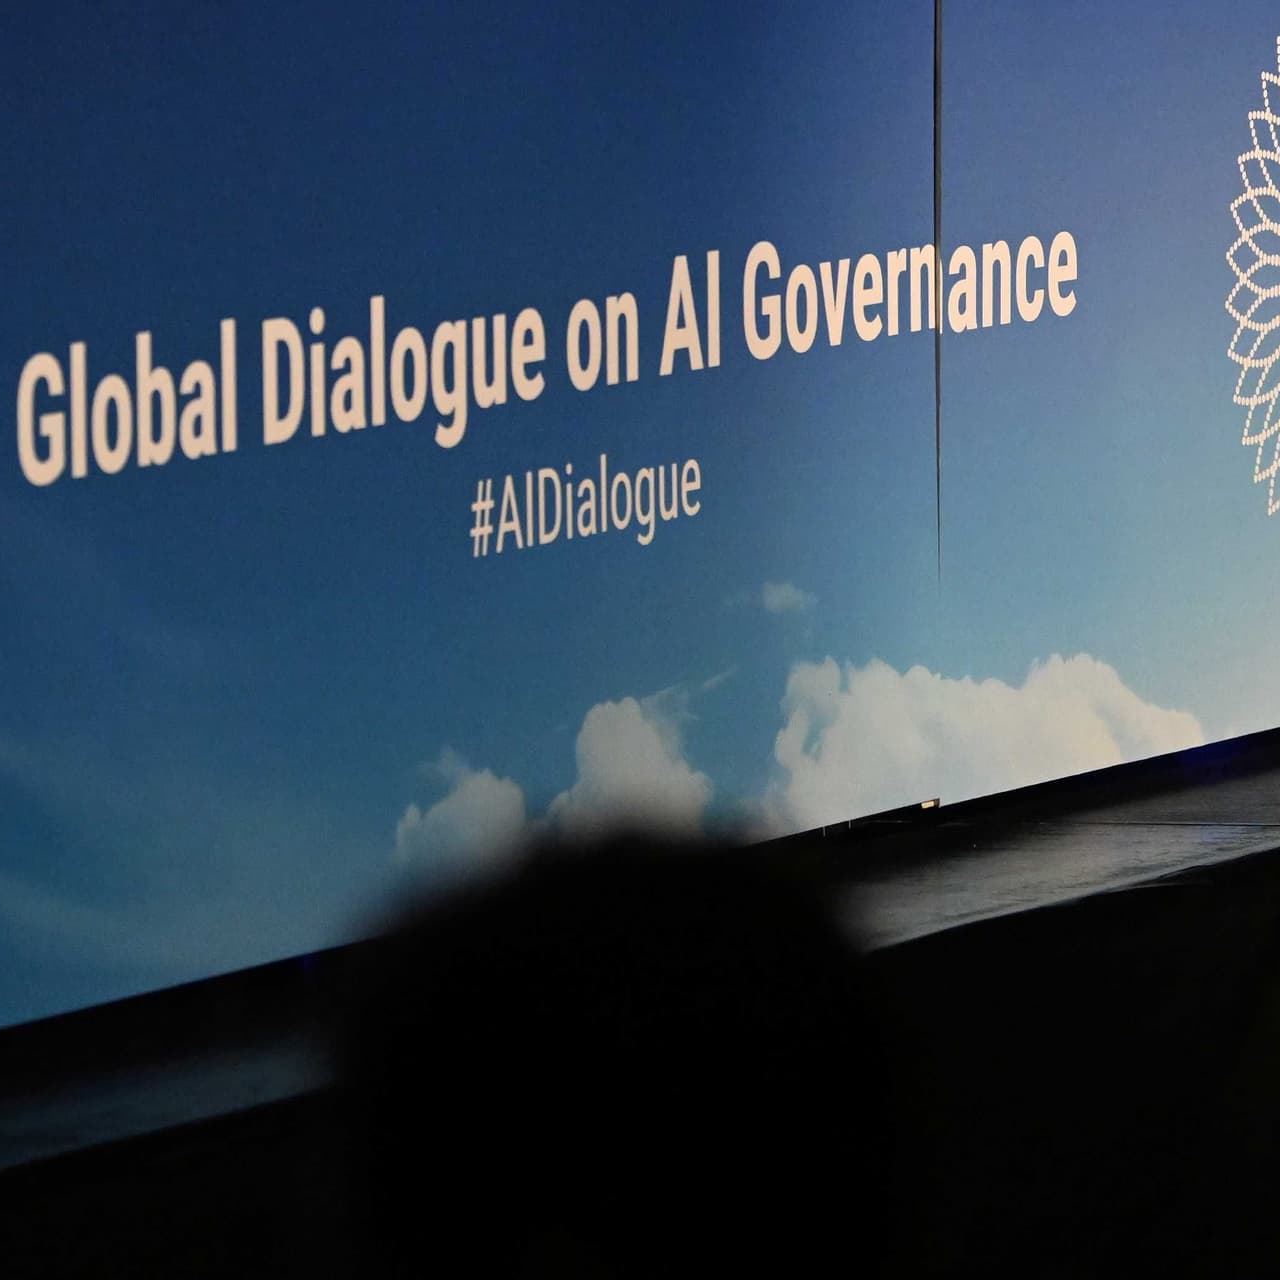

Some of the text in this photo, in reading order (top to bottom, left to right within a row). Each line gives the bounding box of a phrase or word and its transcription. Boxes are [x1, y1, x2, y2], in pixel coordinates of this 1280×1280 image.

[17, 230, 1078, 486] Global Dialogue on AI Governance
[470, 453, 701, 557] #AIDialogue
